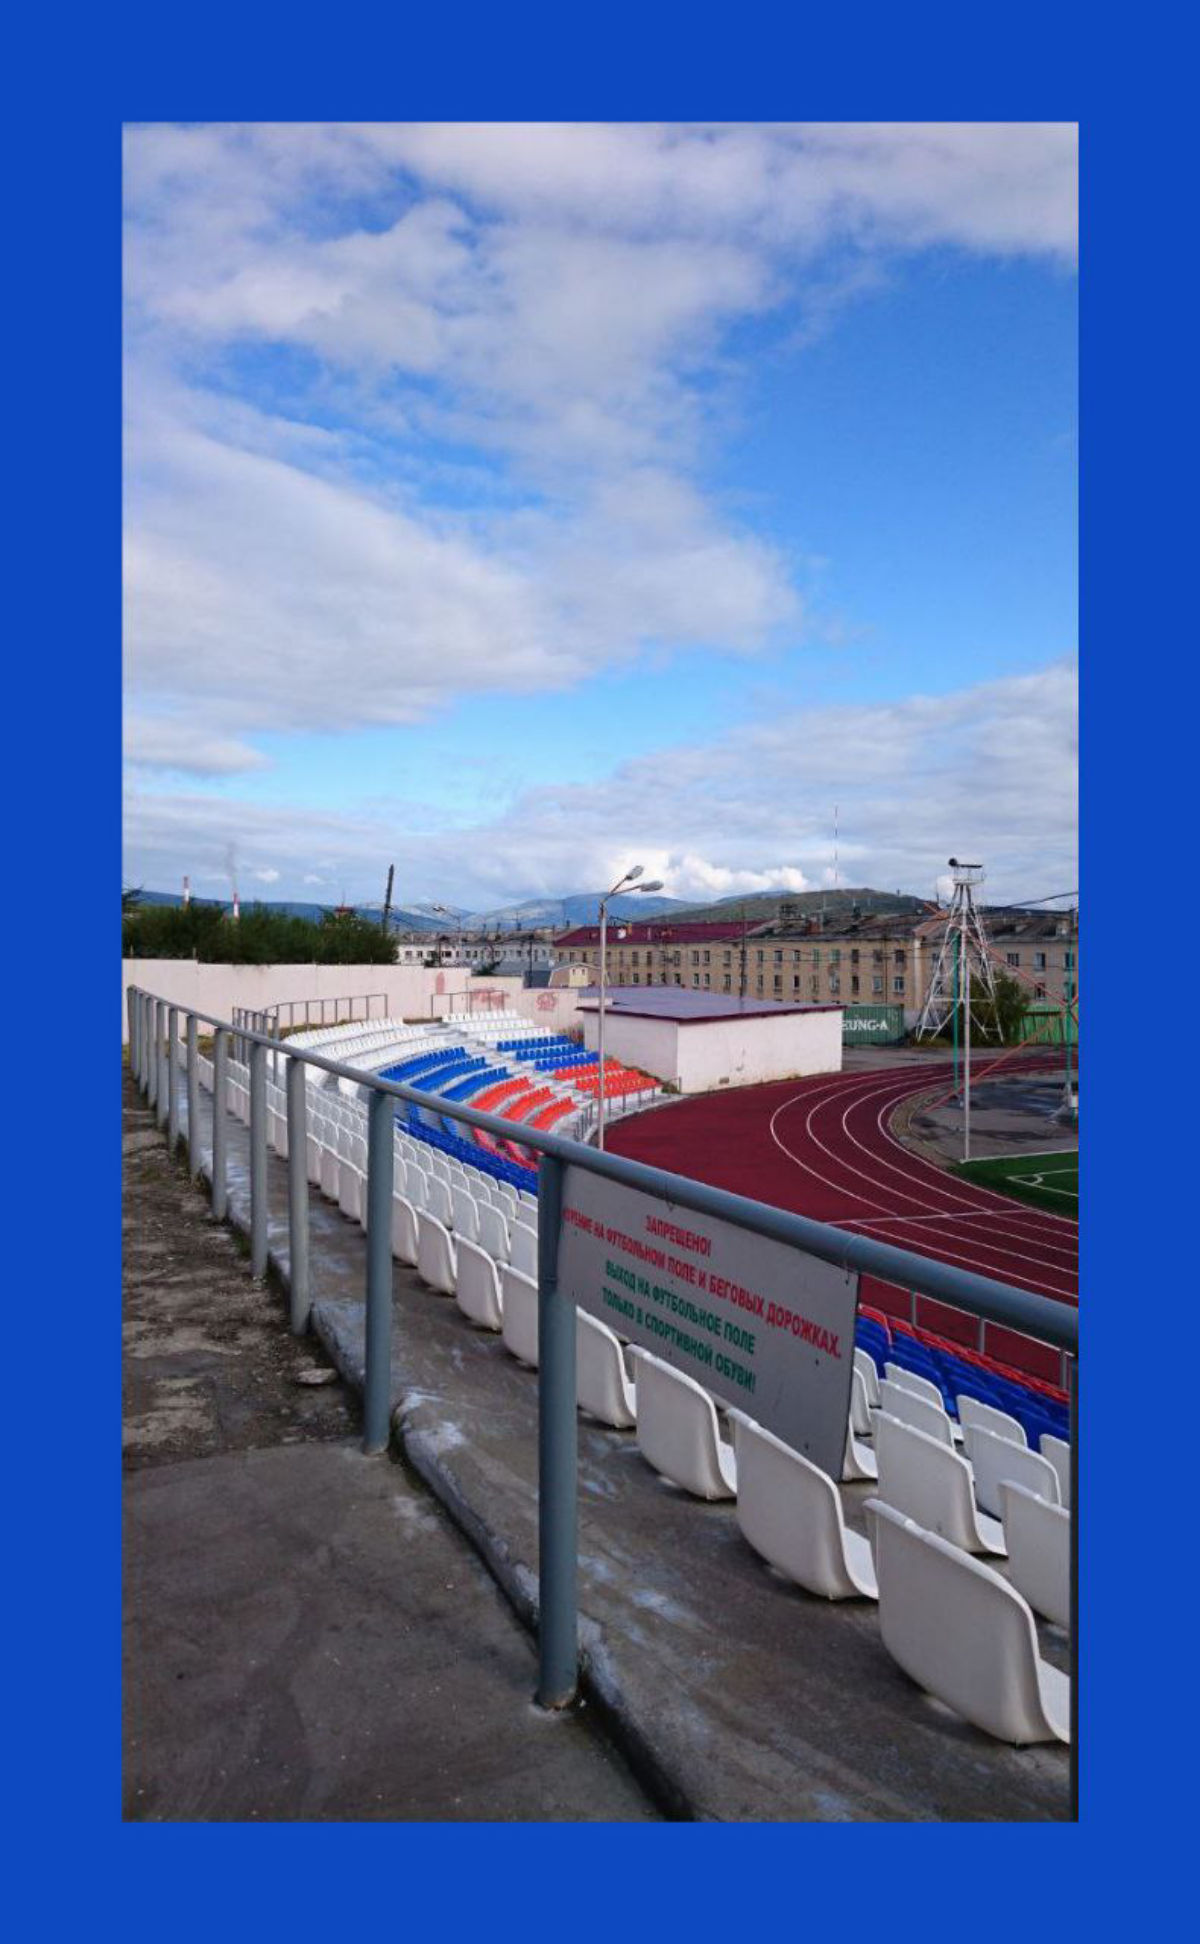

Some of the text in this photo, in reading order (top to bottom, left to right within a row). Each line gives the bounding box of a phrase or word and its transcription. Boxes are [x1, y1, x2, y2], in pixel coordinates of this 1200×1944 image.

[646, 1215, 712, 1257] ЗАПРЕЩЕНО!
[594, 1221, 605, 1240] НА
[606, 1229, 666, 1269] ФУТБОЛЬНОМ
[668, 1256, 696, 1286] ПОЛЕ
[698, 1269, 707, 1289] И
[709, 1275, 765, 1318] БЕГОВЫХ
[766, 1302, 842, 1359] ДОРОЖКАХ.
[602, 1287, 756, 1393] ТОЛЬКО В СПОРТИВНОЙ ОБУВИ!
[606, 1260, 756, 1354] ВЫХОД НА ФУТБОЛЬНОЕ ПОЛЕ
